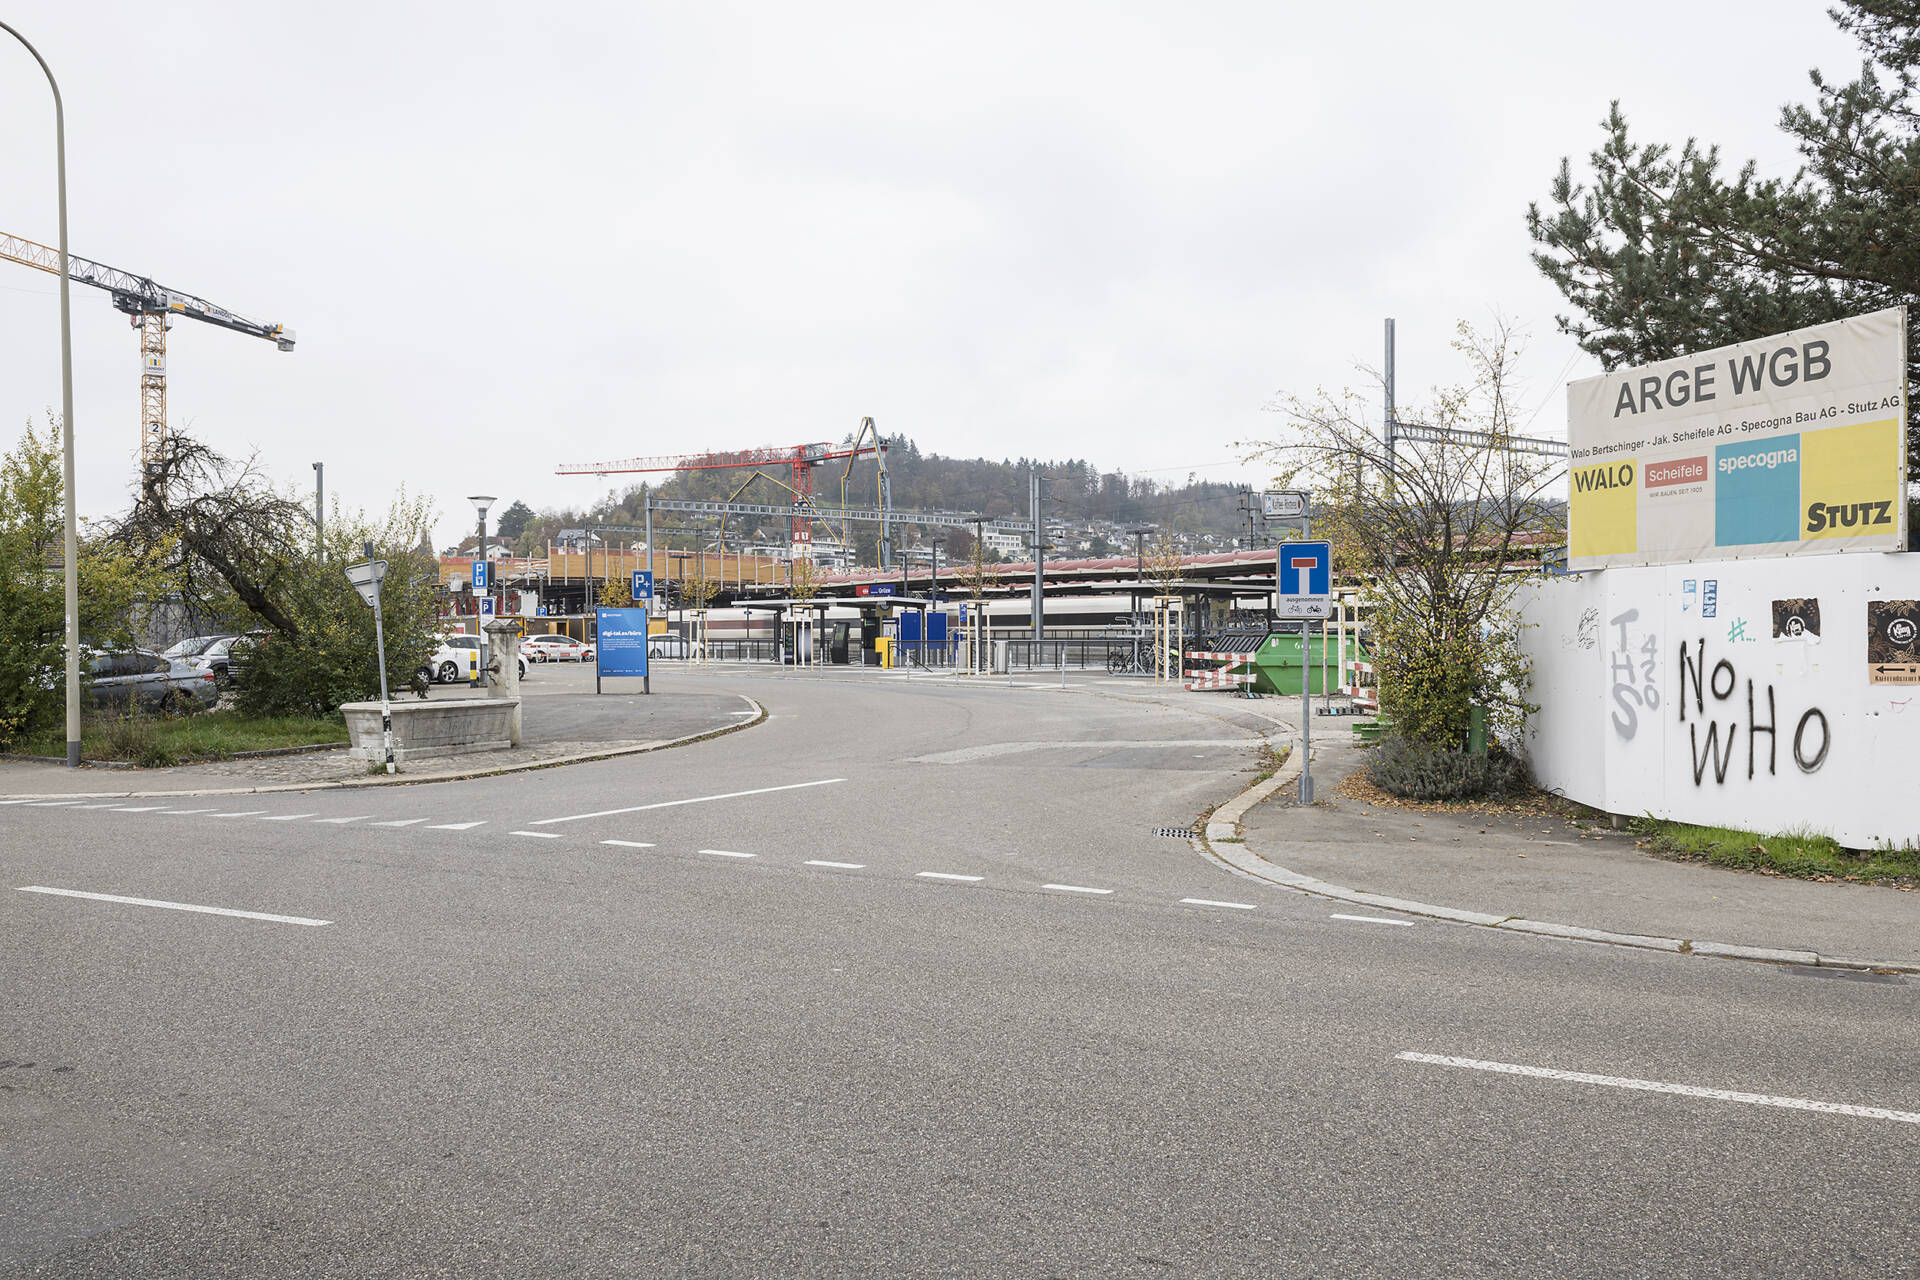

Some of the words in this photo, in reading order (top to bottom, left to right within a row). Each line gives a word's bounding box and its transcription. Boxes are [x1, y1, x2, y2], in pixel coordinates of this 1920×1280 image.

[1613, 364, 1716, 418] ARGE
[1729, 340, 1831, 395] WGB
[1571, 448, 1591, 459] Walo
[1592, 439, 1645, 458] Bertschinger
[1652, 434, 1670, 446] Jak.
[1672, 427, 1715, 443] Scheifele
[1717, 424, 1732, 436] AG
[1741, 416, 1792, 433] Specogna
[1796, 409, 1816, 424] Bau
[1820, 406, 1836, 420] AG
[1848, 399, 1878, 414] Stutz
[1881, 395, 1900, 408] AG
[1649, 464, 1703, 482] Scheifele
[1718, 447, 1797, 475] specogna
[1574, 464, 1633, 493] WALO
[476, 564, 483, 576] P
[1690, 678, 1831, 787] WHO
